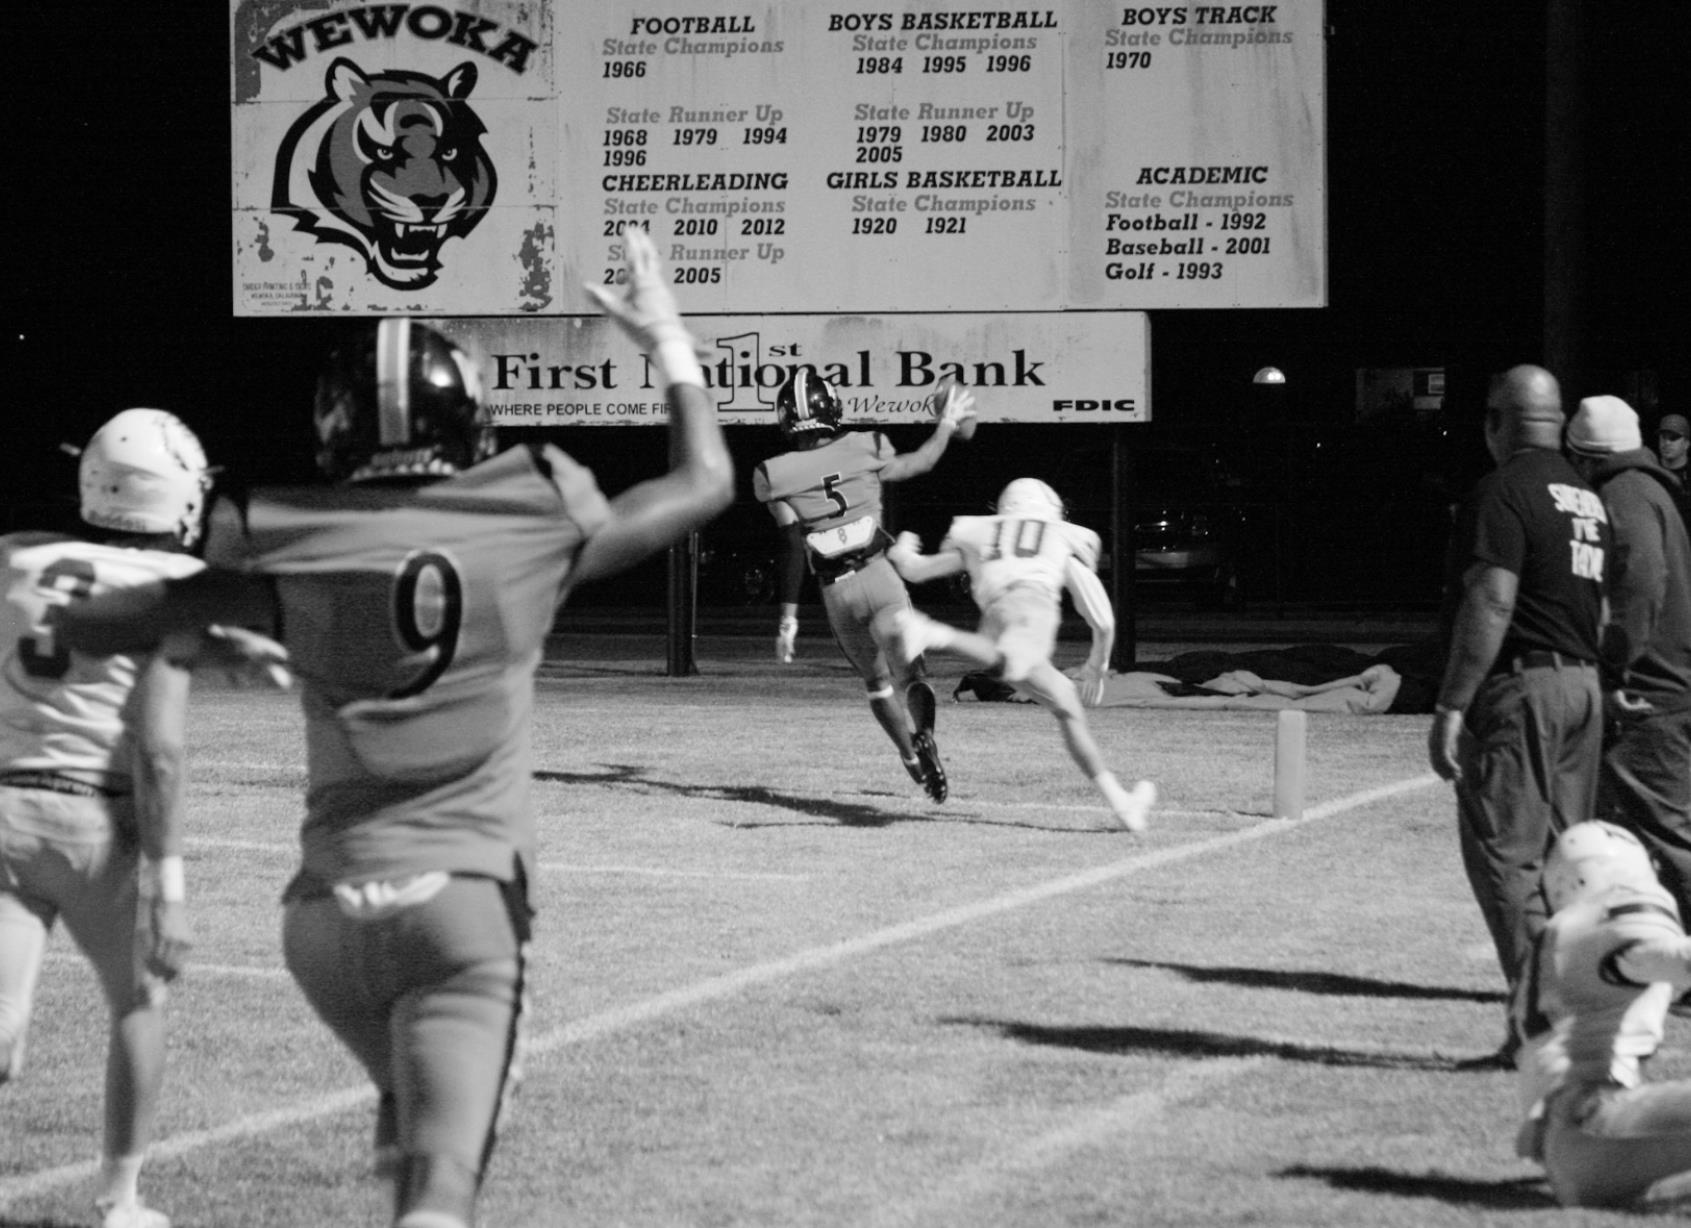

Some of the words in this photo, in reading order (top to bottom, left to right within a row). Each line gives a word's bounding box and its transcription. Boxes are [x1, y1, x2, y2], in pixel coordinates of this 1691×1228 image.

[828, 13, 893, 31] BOYS
[901, 11, 1057, 30] BASKETBALL
[1122, 7, 1187, 25] BOYS
[1195, 6, 1277, 24] TRACK
[631, 16, 755, 35] FOOTBALL
[251, 3, 539, 75] WEWOKA
[602, 38, 657, 55] State
[664, 36, 784, 58] Champions
[853, 34, 907, 51] State
[915, 33, 1037, 54] Champions
[1105, 27, 1161, 46] State
[1169, 26, 1294, 49] Champions
[603, 61, 646, 78] 1966
[857, 57, 902, 74] 1984
[923, 56, 966, 73] 1995
[987, 55, 1031, 72] 1996
[1107, 52, 1151, 69] 1970
[606, 107, 660, 124] State
[668, 106, 748, 123] Runner
[756, 104, 783, 127] Up
[855, 104, 910, 121] State
[918, 103, 998, 120] Runner
[1006, 101, 1034, 123] Up
[603, 130, 647, 146] 1968
[673, 128, 717, 145] 1979
[743, 128, 786, 144] 1994
[857, 126, 901, 143] 1979
[922, 125, 966, 142] 1980
[987, 124, 1034, 141] 2003
[604, 150, 646, 166] 1996
[856, 146, 902, 163] 2005
[602, 173, 788, 192] CHEERLEADING
[827, 172, 898, 189] GIRLS
[906, 170, 1062, 188] BASKETBALL
[1136, 166, 1268, 184] ACADEMIC
[604, 198, 658, 215] State
[666, 197, 785, 218] Champions
[852, 195, 907, 212] State
[914, 195, 1036, 216] Champions
[1105, 191, 1161, 208] State
[1169, 190, 1294, 213] Champions
[603, 219, 650, 236] 204
[674, 219, 718, 235] 2010
[741, 219, 784, 235] 2012
[852, 218, 897, 234] 1920
[926, 217, 966, 233] 1921
[1106, 213, 1198, 231] Football
[1221, 213, 1266, 230] 1992
[670, 244, 749, 260] Runner
[758, 243, 784, 264] Up
[1106, 238, 1203, 255] Baseball
[1226, 237, 1270, 254] 2001
[674, 268, 720, 284] 2005
[1106, 263, 1155, 280] Golf
[1177, 262, 1223, 279] 1993
[491, 353, 617, 389] First
[895, 349, 1046, 386] Bank
[491, 404, 542, 415] WHERE
[547, 403, 601, 415] PEOPLE
[607, 403, 647, 415] COME
[847, 395, 938, 417] Wewok
[1053, 400, 1134, 411] FDIC
[822, 472, 848, 519] 5
[989, 519, 1046, 560] 10
[394, 549, 463, 700] 9
